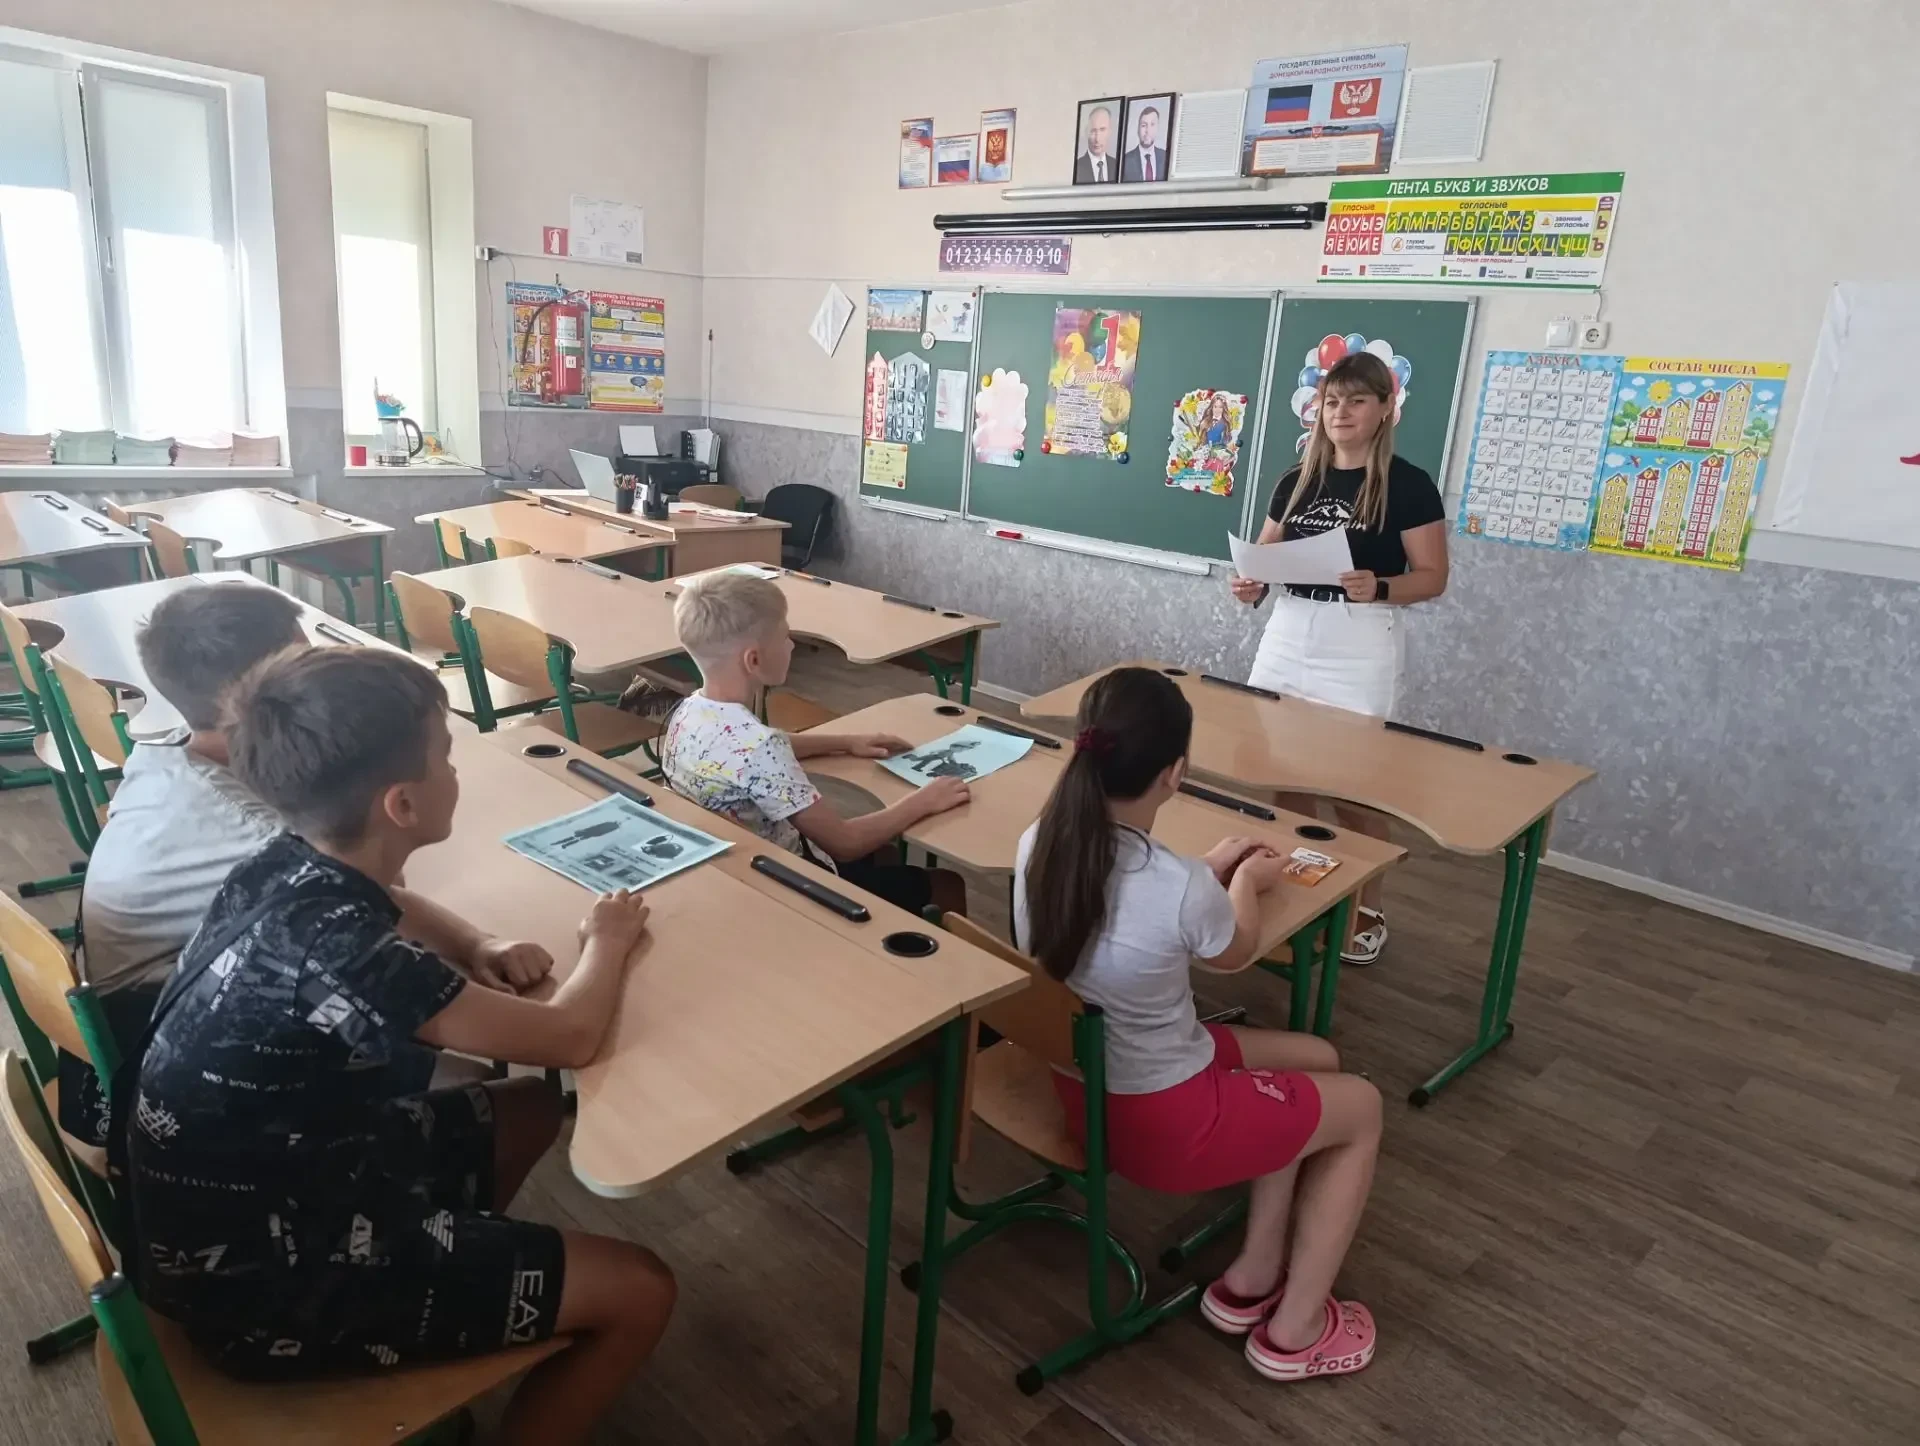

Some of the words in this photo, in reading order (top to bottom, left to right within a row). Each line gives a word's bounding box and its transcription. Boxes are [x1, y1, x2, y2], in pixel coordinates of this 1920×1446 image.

[1278, 56, 1340, 69] ГОСУДАРСТВЕННЫЕ
[1341, 53, 1376, 64] СИМВОЛЫ
[1341, 61, 1386, 72] РЕСПУБЛИКИ
[1386, 181, 1430, 195] ЛЕНТА
[1433, 180, 1471, 194] БУКВ
[1474, 180, 1486, 193] И
[1489, 177, 1549, 192] ЗВУКОВ
[1342, 203, 1376, 211] гласные
[1459, 201, 1508, 210] согласные
[1525, 355, 1581, 366] АЗБУКА
[1648, 360, 1703, 373] СОСТАВ
[1708, 364, 1757, 376] ЧИСЛА
[1305, 1353, 1362, 1374] crocs
